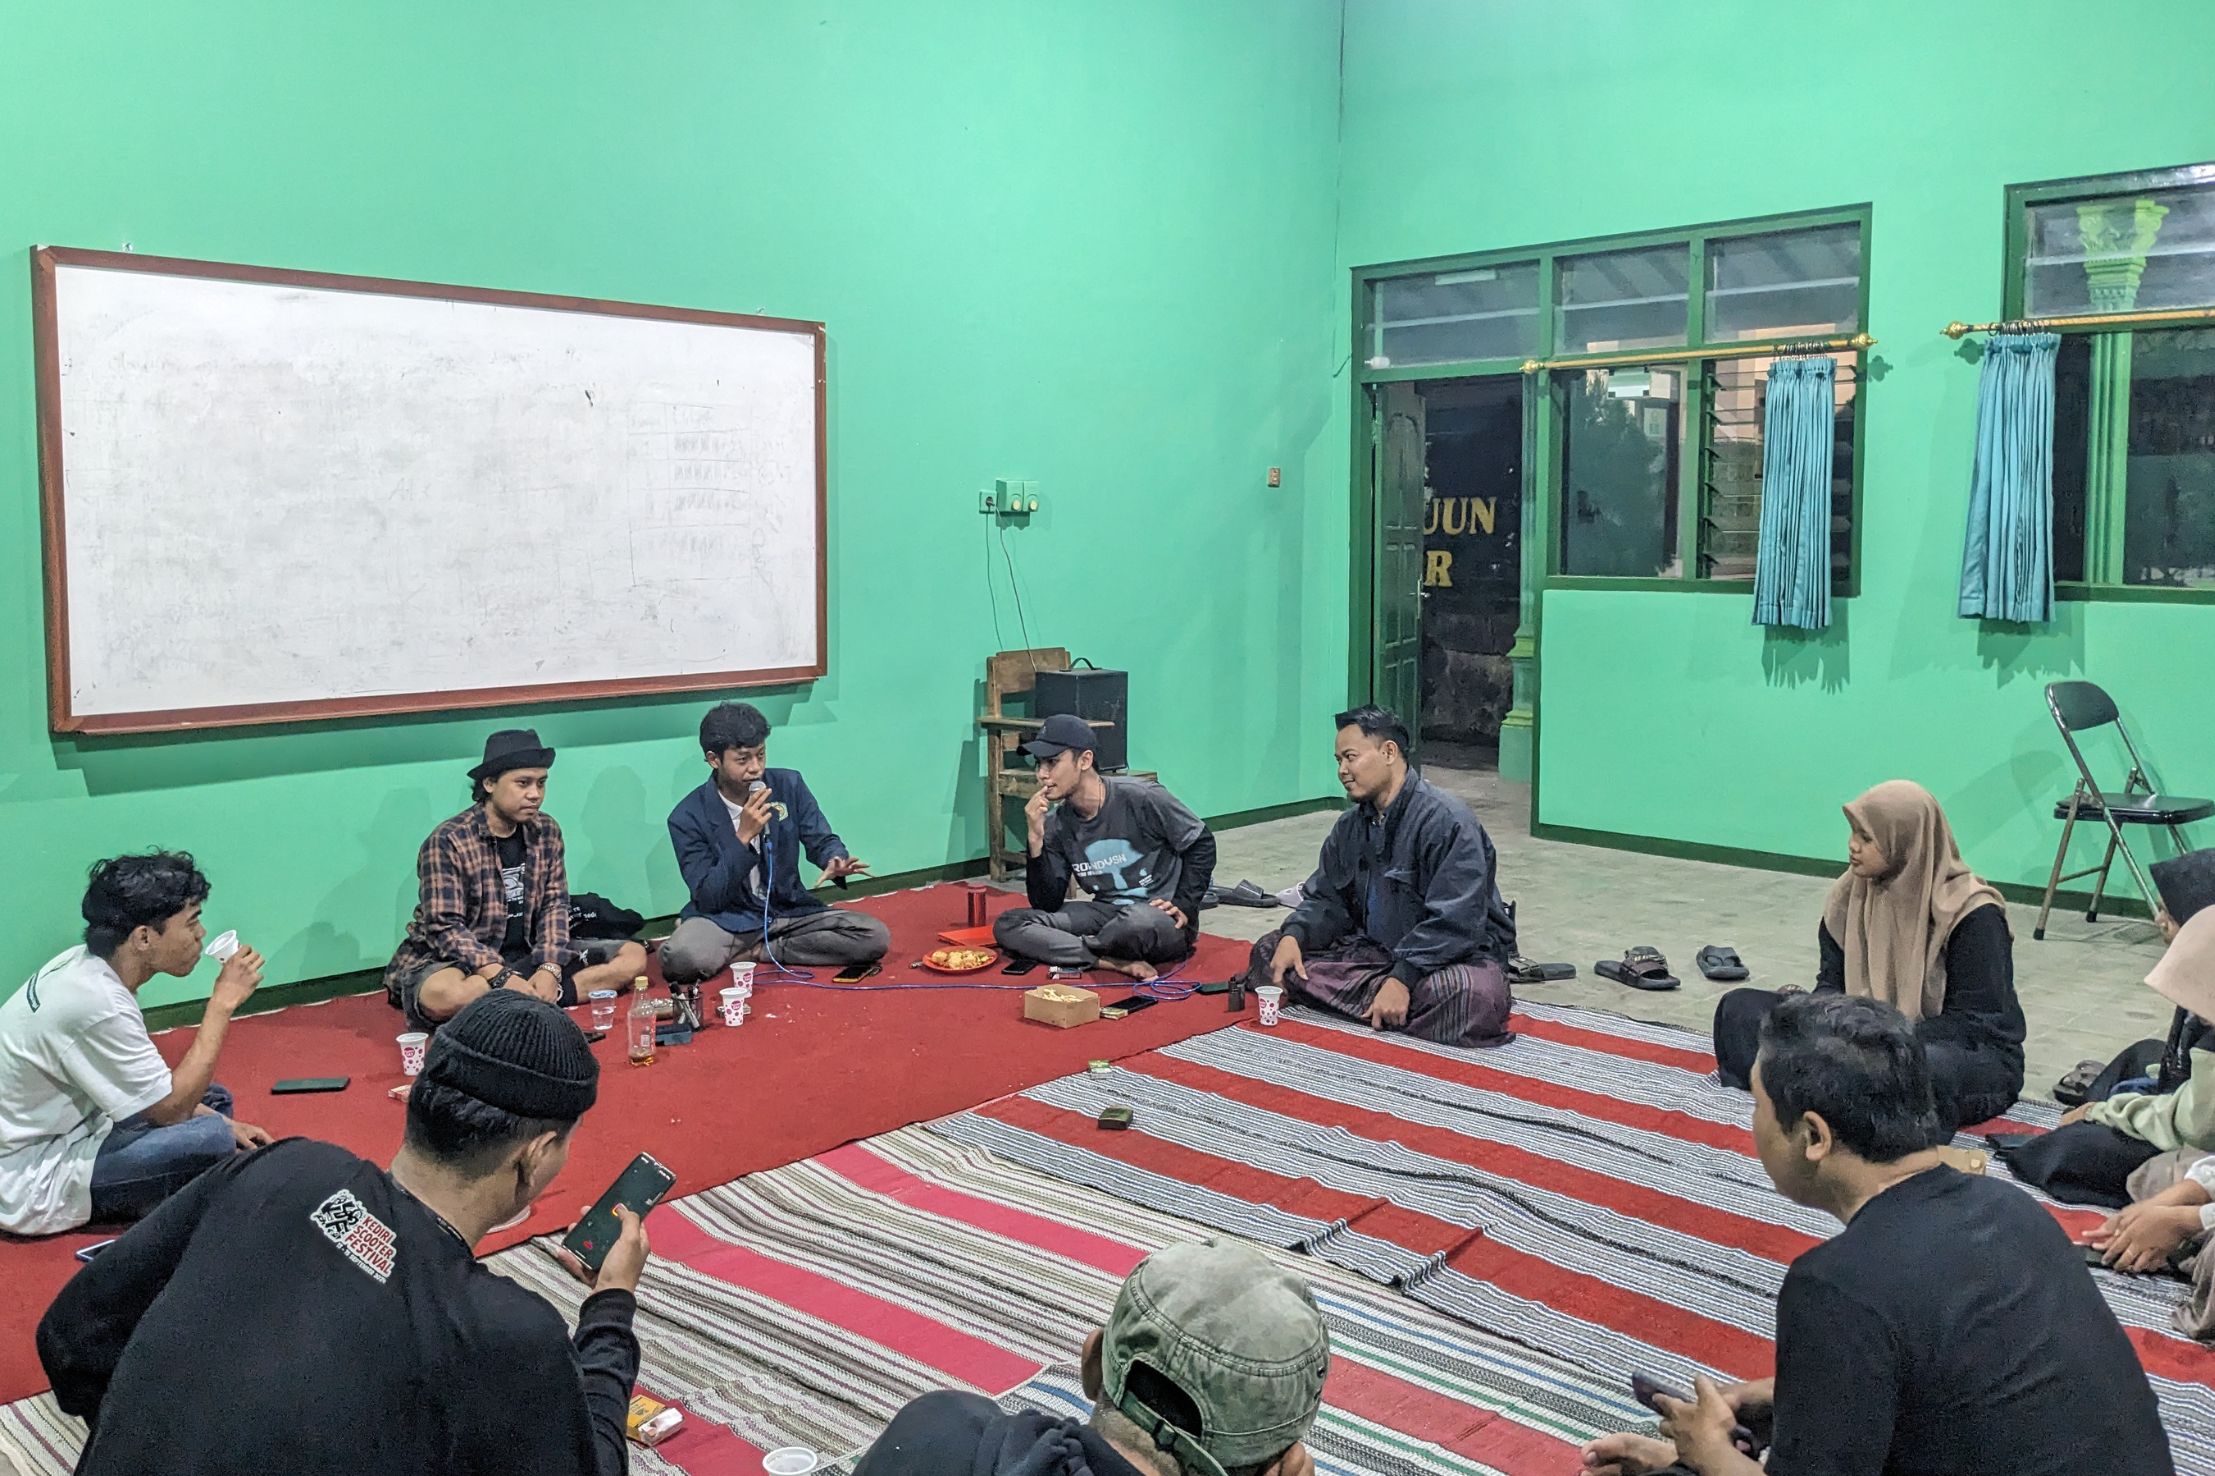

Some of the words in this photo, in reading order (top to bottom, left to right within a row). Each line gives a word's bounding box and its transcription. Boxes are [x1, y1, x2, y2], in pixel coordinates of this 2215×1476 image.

[353, 1225, 394, 1259] SCOOTER
[362, 1216, 394, 1243] KEDIRI
[345, 1233, 392, 1275] FESTIVAL
